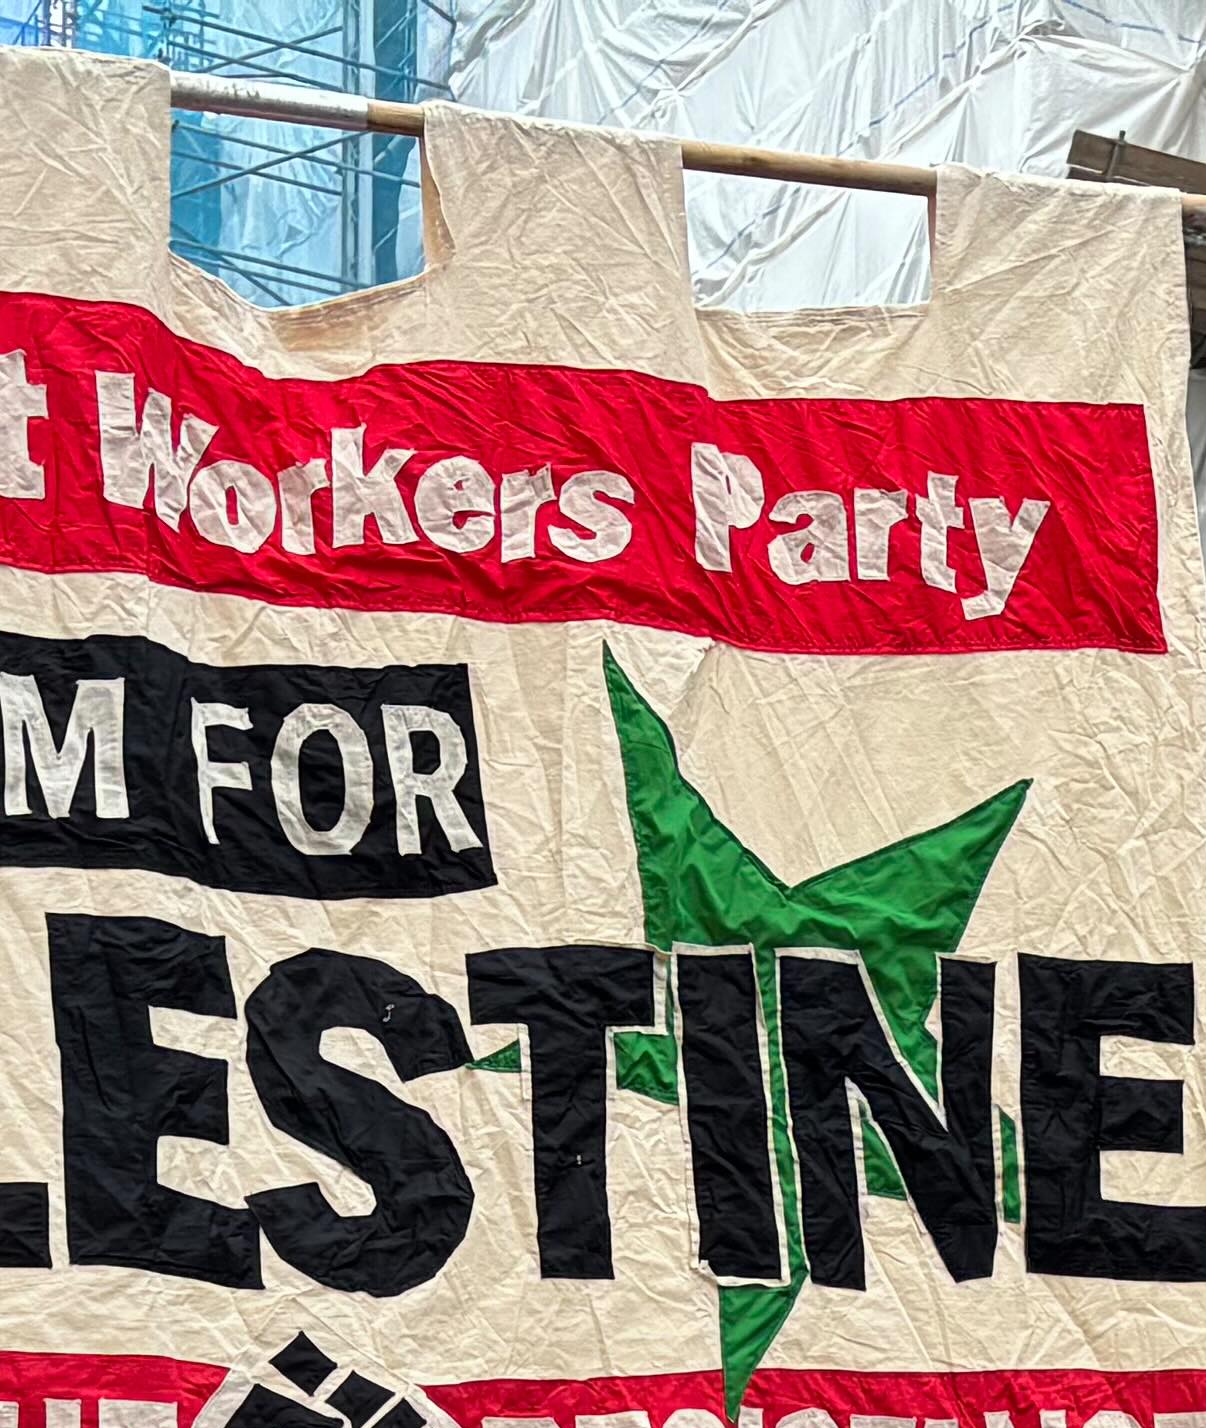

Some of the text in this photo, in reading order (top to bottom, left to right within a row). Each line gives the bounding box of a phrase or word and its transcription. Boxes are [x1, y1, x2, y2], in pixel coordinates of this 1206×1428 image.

[95, 370, 637, 564] Workers
[691, 441, 1051, 619] Party
[190, 695, 484, 857] FOR
